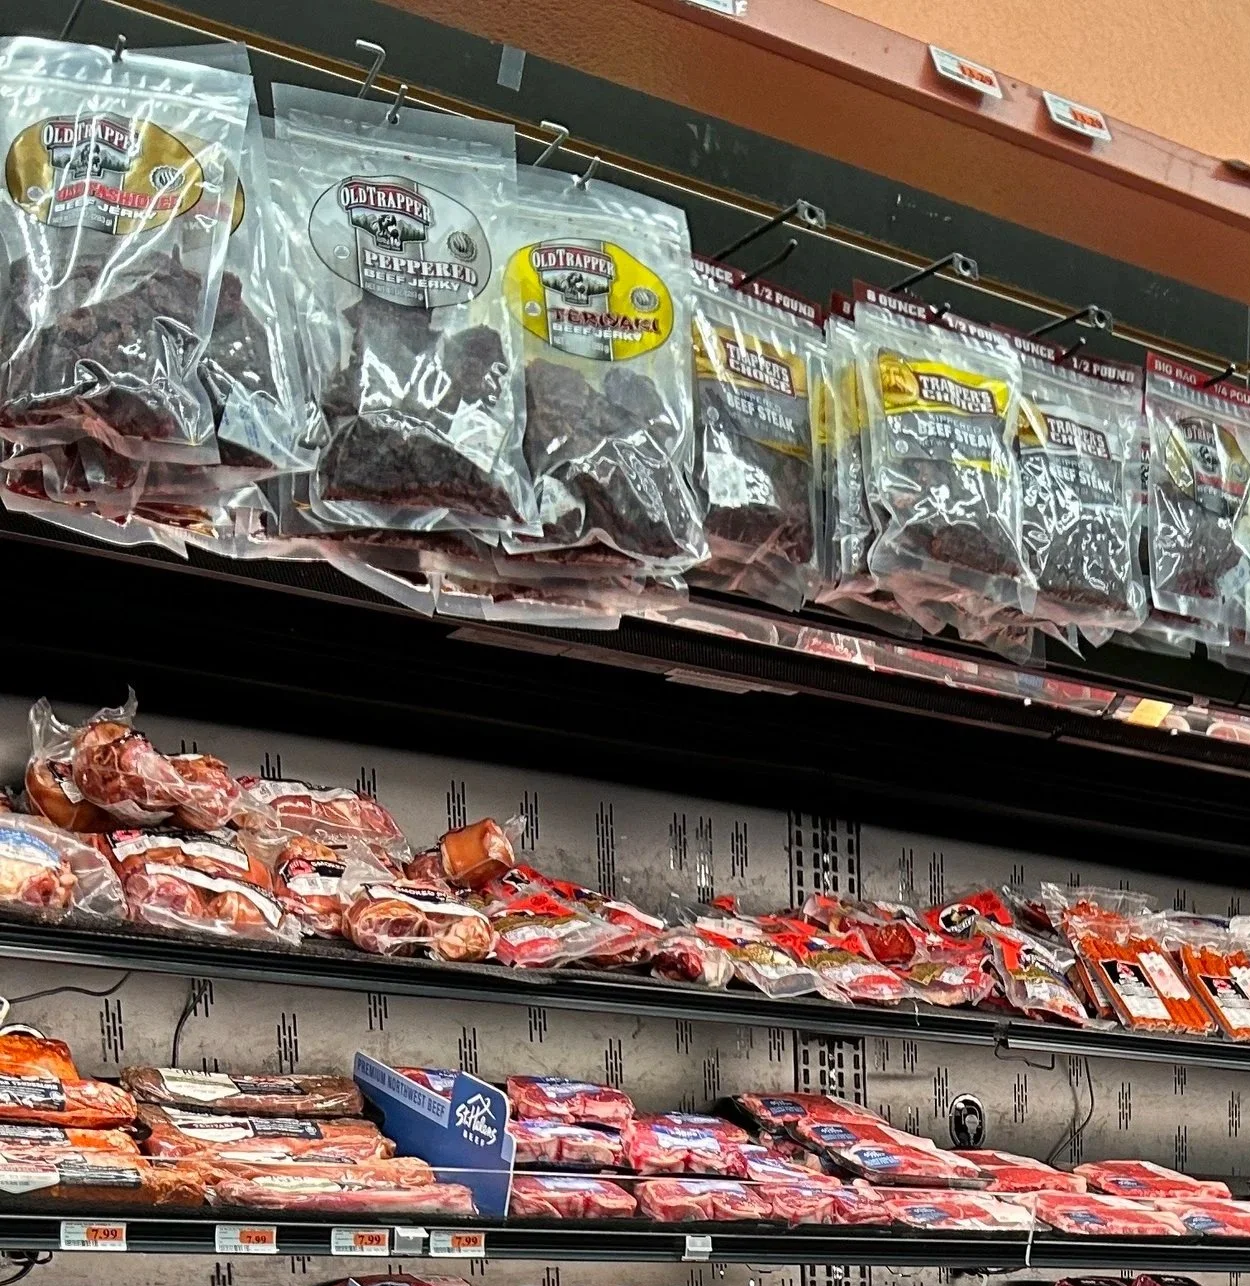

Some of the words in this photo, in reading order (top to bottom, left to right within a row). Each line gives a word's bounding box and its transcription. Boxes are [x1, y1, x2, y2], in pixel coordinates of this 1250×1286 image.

[43, 124, 74, 146] OLD
[78, 120, 140, 152] TRAPP
[54, 199, 95, 213] BEEF
[340, 187, 367, 207] OLD
[366, 187, 431, 222] TRAPPER
[364, 250, 478, 286] PEPPERED
[532, 251, 556, 268] OLD
[556, 249, 616, 276] TRAPPER
[364, 268, 405, 284] BEEF
[408, 278, 460, 292] JERKY
[753, 282, 774, 301] 1/2
[774, 292, 816, 319] POUND
[879, 294, 927, 320] OUNCE
[550, 308, 662, 334] TERIYAKI
[552, 322, 592, 336] BEEF
[593, 329, 643, 341] JERKY
[949, 316, 967, 332] 1/2
[1014, 336, 1056, 362] OUNCE
[726, 342, 790, 383] TRAPPER'S
[1071, 356, 1091, 373] 1/2
[1092, 362, 1136, 383] POUND
[1154, 359, 1174, 376] BIG
[1175, 368, 1198, 385] BAG
[729, 359, 793, 395] CHOICE
[918, 374, 992, 404] TRAPPER'S
[921, 390, 994, 414] CHOICE
[1213, 383, 1229, 398] 1/4
[727, 393, 755, 417] BEEF
[757, 404, 796, 434] STEAK
[918, 420, 952, 438] BEEF
[1078, 470, 1114, 494] STEAK
[357, 1057, 387, 1087] PREMIUM
[387, 1075, 427, 1109] NORTHWEST
[427, 1099, 447, 1120] BEEF
[462, 1130, 486, 1148] BEEF
[91, 1229, 118, 1241] 7.99
[246, 1235, 267, 1245] 7.99
[357, 1234, 381, 1246] 7.99
[455, 1235, 479, 1247] 7.99
